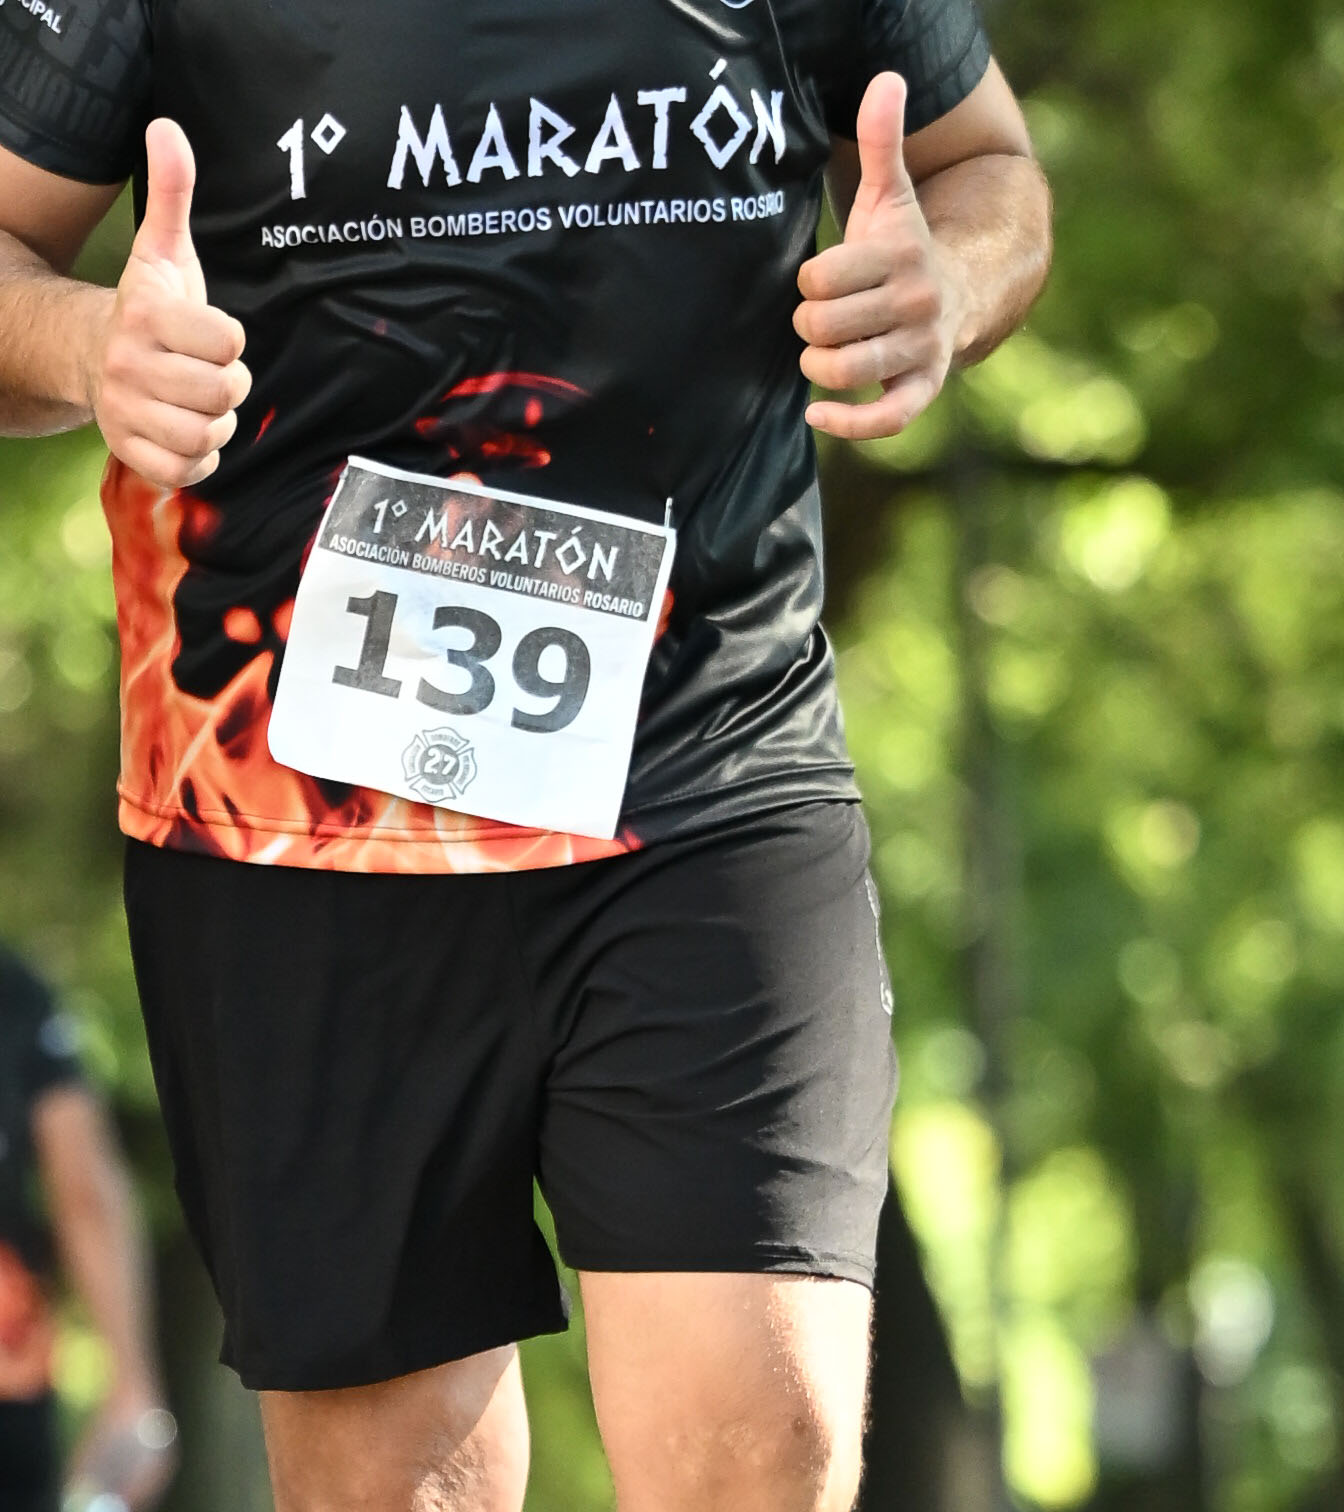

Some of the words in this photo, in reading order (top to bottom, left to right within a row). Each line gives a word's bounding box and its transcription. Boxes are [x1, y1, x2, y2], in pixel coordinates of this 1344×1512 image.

[386, 57, 787, 190] MARATÓN
[261, 214, 404, 249] ASOCIACIÓN
[410, 207, 552, 238] BOMBEROS
[558, 197, 727, 230] VOLUNTARIOS
[328, 533, 410, 568] ASOCIACIÓN
[412, 551, 487, 585] BOMBEROS
[489, 569, 581, 604] VOLUNTARIOS
[582, 591, 644, 619] ROSARIO
[414, 507, 619, 582] MARATÓN
[331, 589, 592, 734] 139
